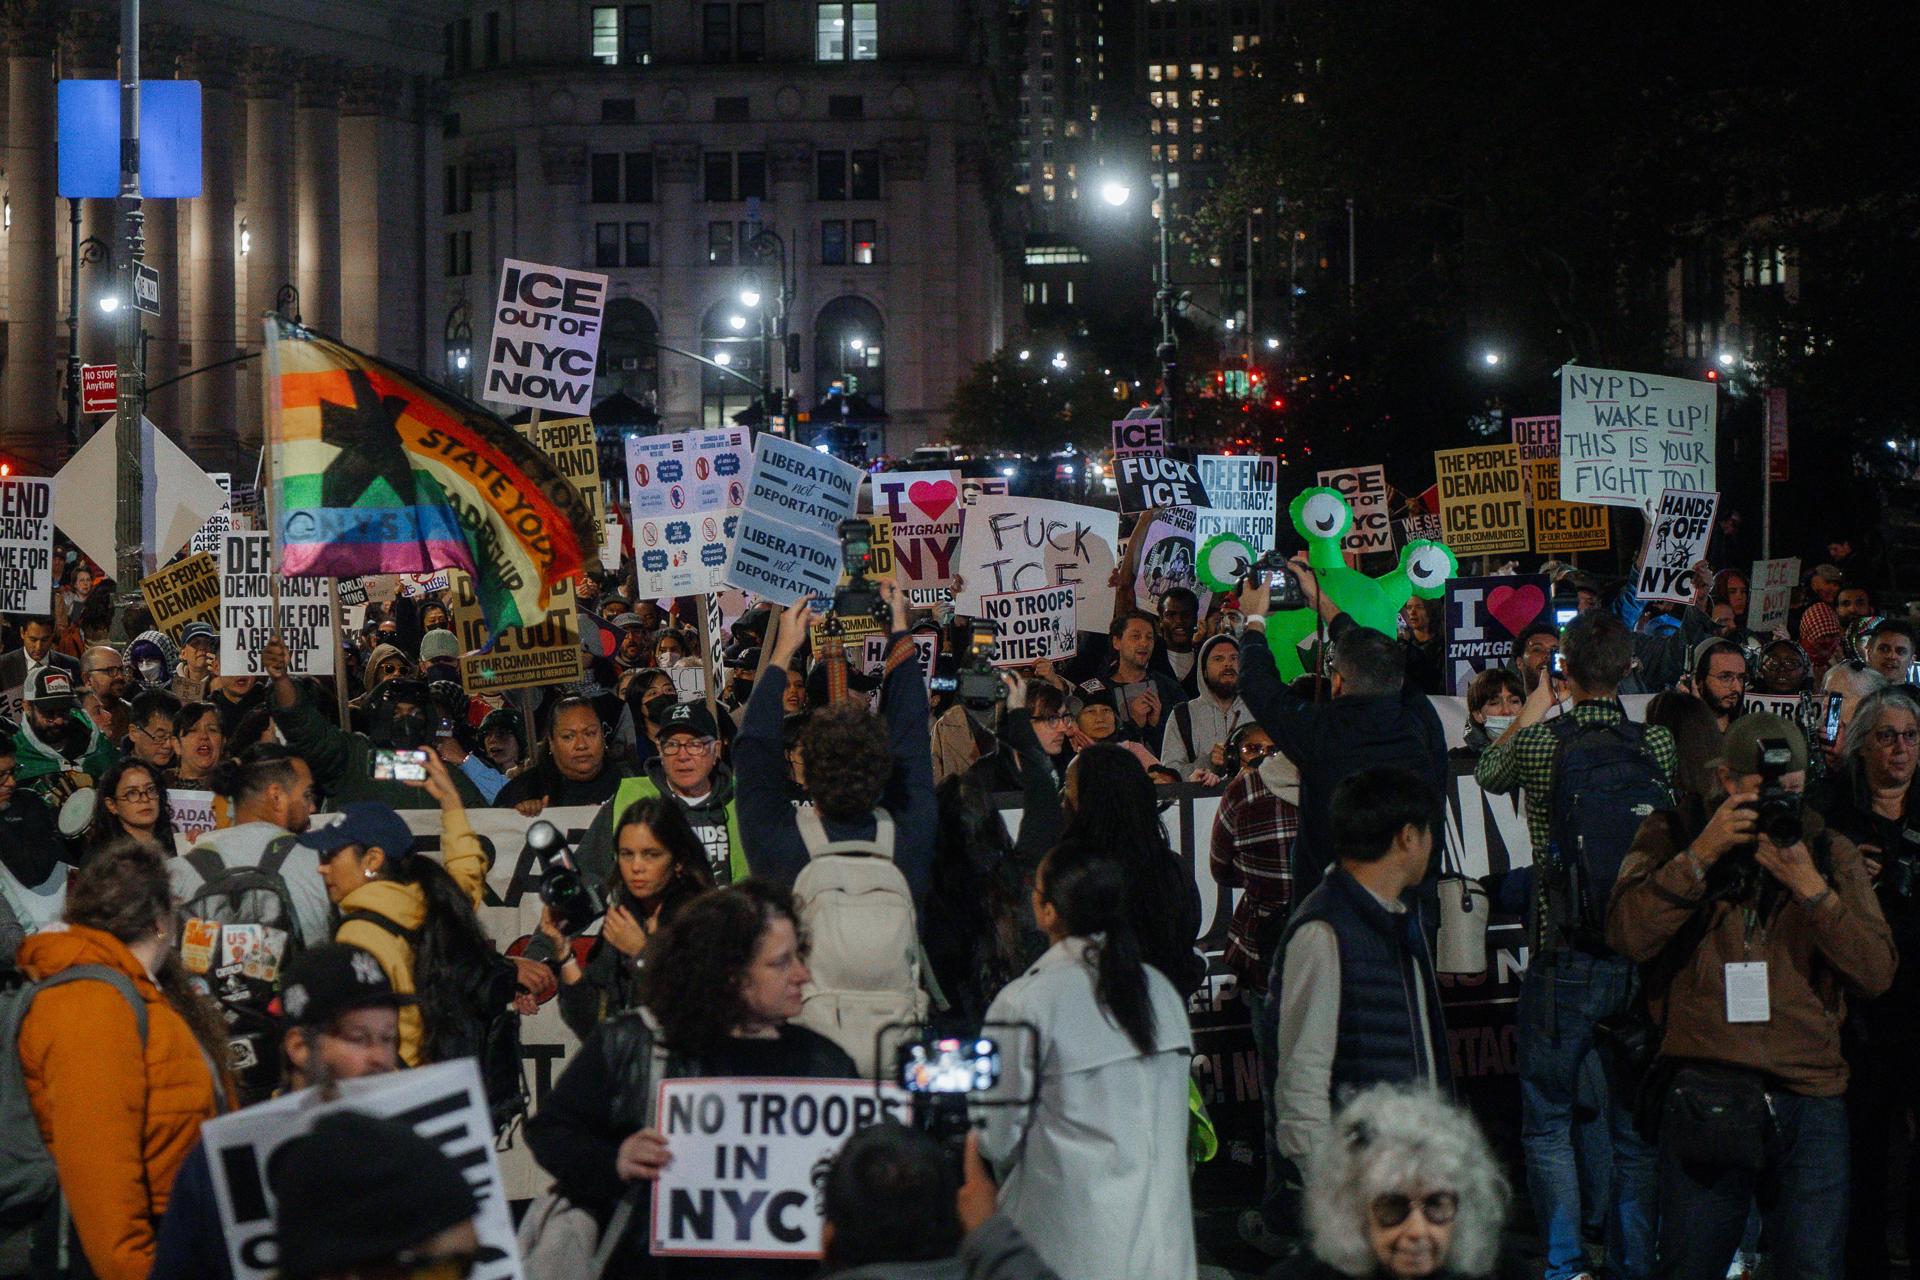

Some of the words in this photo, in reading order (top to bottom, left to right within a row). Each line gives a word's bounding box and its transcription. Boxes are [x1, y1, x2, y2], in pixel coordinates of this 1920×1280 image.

[503, 268, 602, 317] ICE
[499, 307, 557, 331] OUT
[558, 317, 598, 337] OF
[493, 336, 593, 376] NYC
[85, 370, 95, 380] NO
[86, 381, 115, 392] Anytime
[489, 369, 591, 405] NOW
[1594, 404, 1658, 427] WAKE
[1668, 404, 1709, 432] UP!
[542, 423, 592, 449] PEOPLE
[1114, 424, 1162, 448] ICE
[1564, 431, 1616, 458] THIS
[1630, 436, 1648, 458] IS
[1659, 440, 1712, 465] YOUR
[418, 428, 513, 499] STATE
[762, 449, 853, 495] LIBERATION
[1122, 457, 1197, 484] FUCK
[1439, 454, 1466, 473] THE
[1467, 449, 1518, 470] PEOPLE
[1535, 464, 1558, 479] THE
[1202, 459, 1274, 491] DEFEND
[1320, 471, 1384, 494] ICE
[1442, 469, 1520, 498] DEMAND
[1576, 466, 1653, 495] FIGHT
[1659, 469, 1704, 491] TOO!
[0, 481, 49, 518] END
[792, 481, 820, 498] not
[881, 483, 907, 522] I
[1142, 482, 1192, 510] ICE
[1207, 491, 1273, 511] EMOCRACY:
[1360, 494, 1384, 506] OF
[1445, 504, 1478, 532] ICE
[1481, 501, 1521, 529] OUT
[1539, 507, 1566, 531] ICE
[1570, 505, 1604, 528] OUT
[1661, 495, 1715, 519] HANDS
[989, 512, 1091, 563] FUCK
[1199, 515, 1221, 534] IT'S
[1223, 516, 1250, 535] TIME
[1252, 517, 1273, 536] FOR
[1401, 517, 1422, 531] WE
[1447, 535, 1455, 544] OF
[1456, 533, 1472, 543] OUR
[1472, 530, 1525, 542] COMMUNITIES!
[1561, 530, 1606, 541] COMMUNITIES!
[1673, 517, 1708, 541] OFF
[19, 548, 48, 570] FOR
[743, 525, 838, 570] LIBERATION
[893, 536, 960, 580] NY
[144, 576, 169, 600] THE
[169, 555, 214, 590] PEOPLE
[773, 557, 801, 574] not
[1765, 562, 1789, 586] ICE
[224, 575, 329, 598] DEMORACY:
[1640, 566, 1695, 597] NYC
[153, 575, 220, 622] DEMAND
[985, 598, 1011, 619] NO
[1016, 589, 1073, 616] TROOPS
[1763, 591, 1786, 612] OUT
[225, 606, 255, 628] IT'S
[298, 605, 330, 628] FOR
[1013, 617, 1051, 635] OUR
[1454, 588, 1484, 641] I
[236, 628, 246, 650] A
[515, 608, 570, 650] OUT
[994, 622, 1008, 637] N
[467, 660, 480, 674] OF
[480, 657, 502, 673] OUR
[503, 648, 577, 670] COMMUNITIES!
[989, 634, 1052, 661] CITIES!
[227, 933, 247, 945] US
[668, 1094, 725, 1136] NO
[715, 1145, 768, 1180] IN
[669, 1188, 808, 1242] NYC
